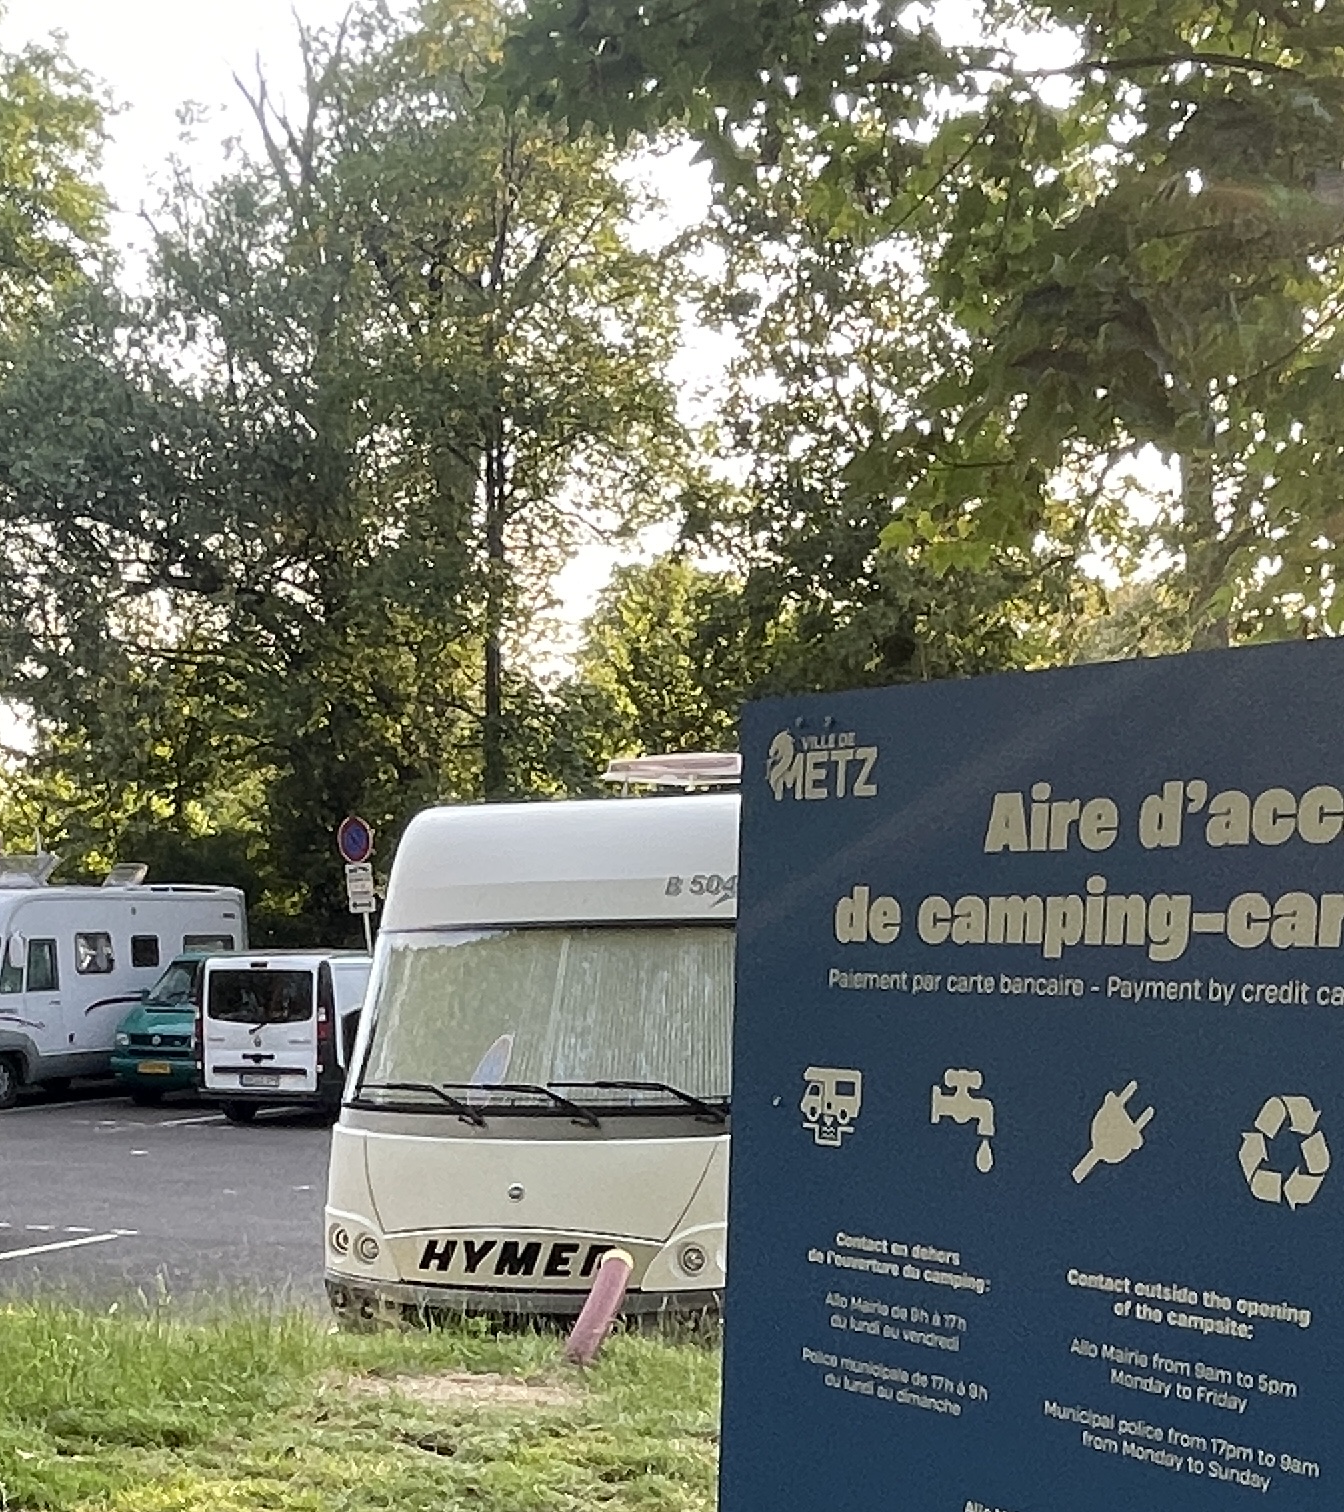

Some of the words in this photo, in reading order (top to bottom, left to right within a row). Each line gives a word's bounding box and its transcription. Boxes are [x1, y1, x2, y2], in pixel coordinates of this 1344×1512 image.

[768, 744, 877, 800] METZ
[984, 781, 1119, 853] Aire
[664, 876, 684, 897] B
[835, 886, 901, 944] de
[828, 968, 907, 991] Paiement
[912, 971, 942, 995] par
[946, 972, 996, 994] carte
[999, 973, 1084, 997] bancaire
[1107, 976, 1203, 1003] Payment
[1208, 978, 1236, 1006] by
[1241, 980, 1311, 1005] credit
[808, 1248, 824, 1264] de
[836, 1232, 888, 1254] Contact
[911, 1244, 961, 1266] dehors
[1067, 1268, 1131, 1295] Contact
[1134, 1281, 1198, 1306] outside
[1202, 1290, 1232, 1312] the
[1236, 1297, 1312, 1328] opening
[1113, 1299, 1132, 1317] of
[1136, 1301, 1163, 1324] the
[903, 1328, 960, 1352] vendredi
[802, 1346, 838, 1368] Police
[840, 1357, 910, 1384] municipale
[1070, 1336, 1098, 1359] Allo
[1101, 1343, 1148, 1368] Mairie
[1152, 1352, 1191, 1377] from
[1194, 1362, 1232, 1385] 9am
[1236, 1371, 1254, 1390] to
[1258, 1373, 1298, 1398] 5pm
[896, 1388, 962, 1417] dimanche
[1110, 1368, 1173, 1398] Monday
[1176, 1382, 1192, 1400] to
[1196, 1386, 1249, 1414] Friday
[1044, 1400, 1115, 1431] Municipal
[1118, 1418, 1164, 1442] police
[1167, 1426, 1206, 1452] from
[1210, 1437, 1253, 1463] 17pm
[1257, 1449, 1276, 1468] to
[1280, 1453, 1320, 1478] 9am
[1081, 1430, 1118, 1455] from
[1122, 1440, 1185, 1473] Monday
[1187, 1456, 1205, 1475] to
[1208, 1460, 1272, 1493] Sunday
